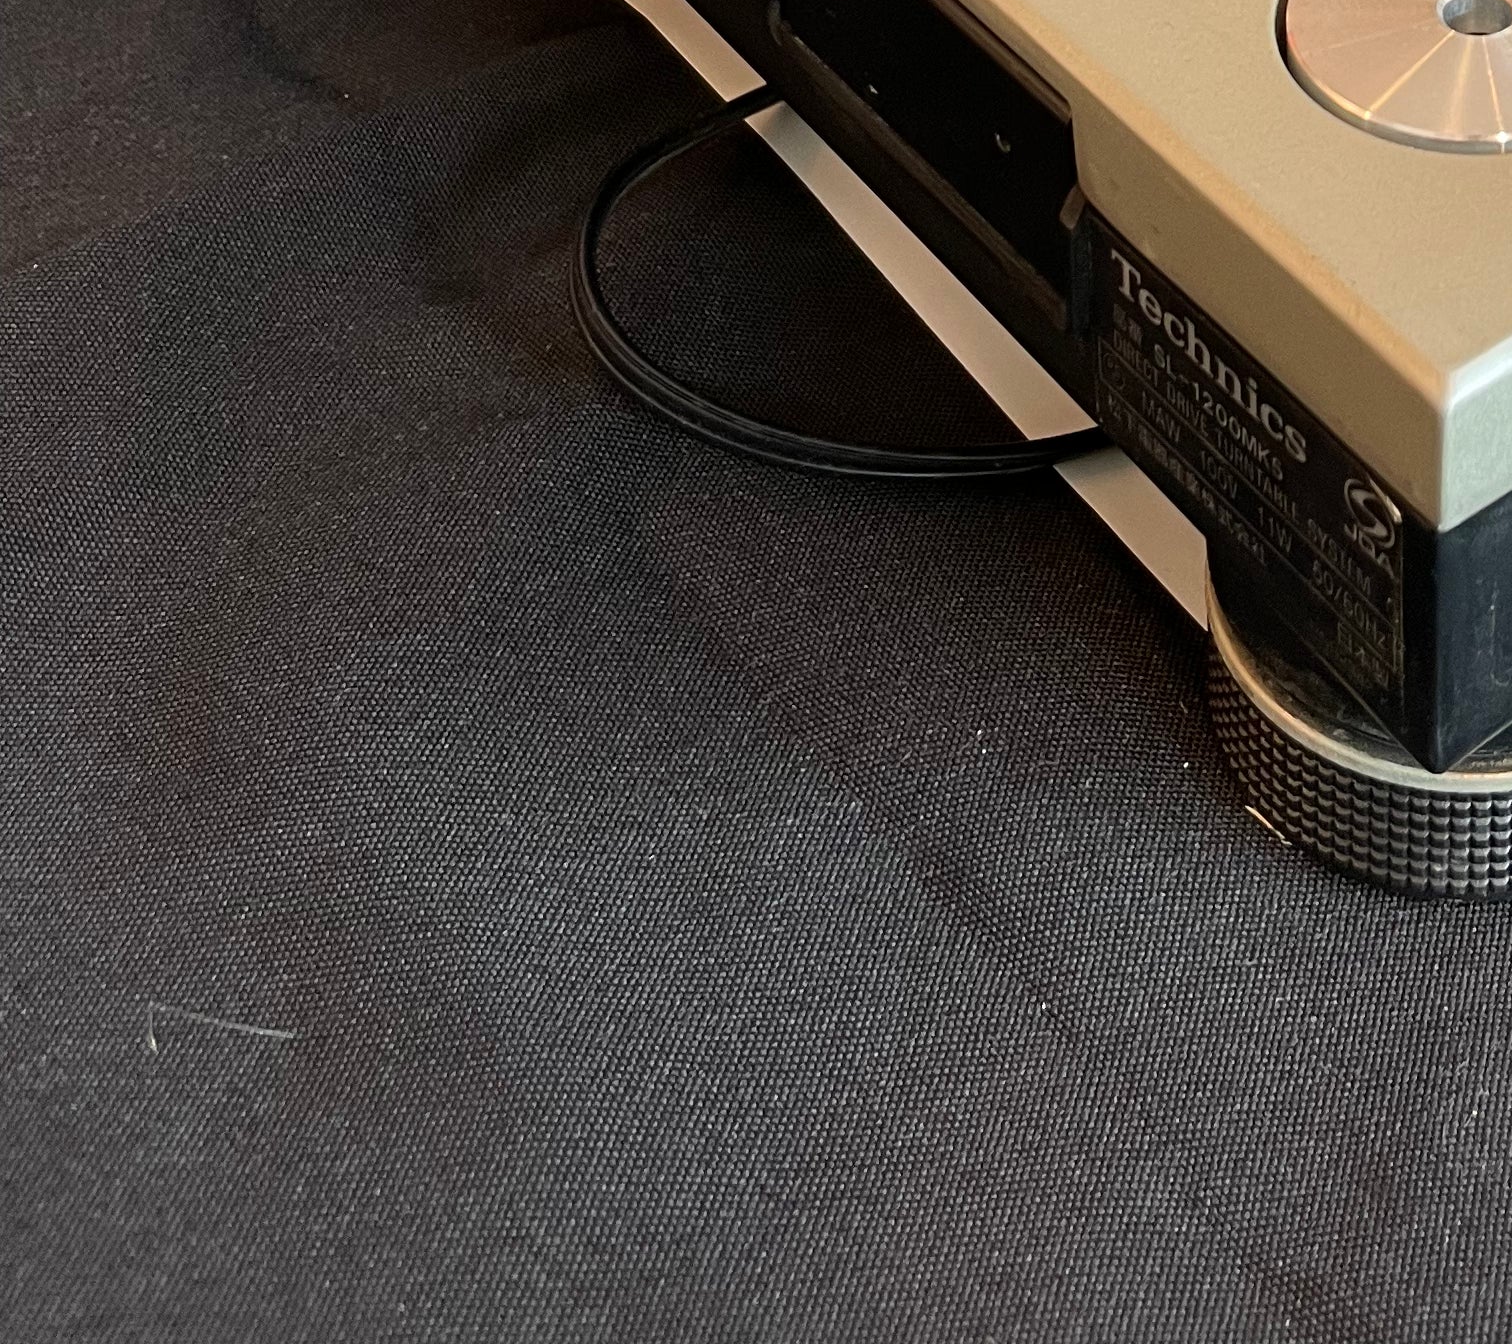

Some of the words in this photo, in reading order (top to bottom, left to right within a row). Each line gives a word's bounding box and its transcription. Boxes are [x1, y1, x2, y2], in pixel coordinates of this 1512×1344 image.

[1111, 249, 1307, 463] Technics
[1113, 325, 1158, 390] DIRECT
[1166, 377, 1208, 439] DRIVE
[1217, 426, 1299, 526] TURNTABLE
[1307, 514, 1371, 599] SYSTEM
[1200, 444, 1237, 505] 100V
[1257, 502, 1292, 559] 11W
